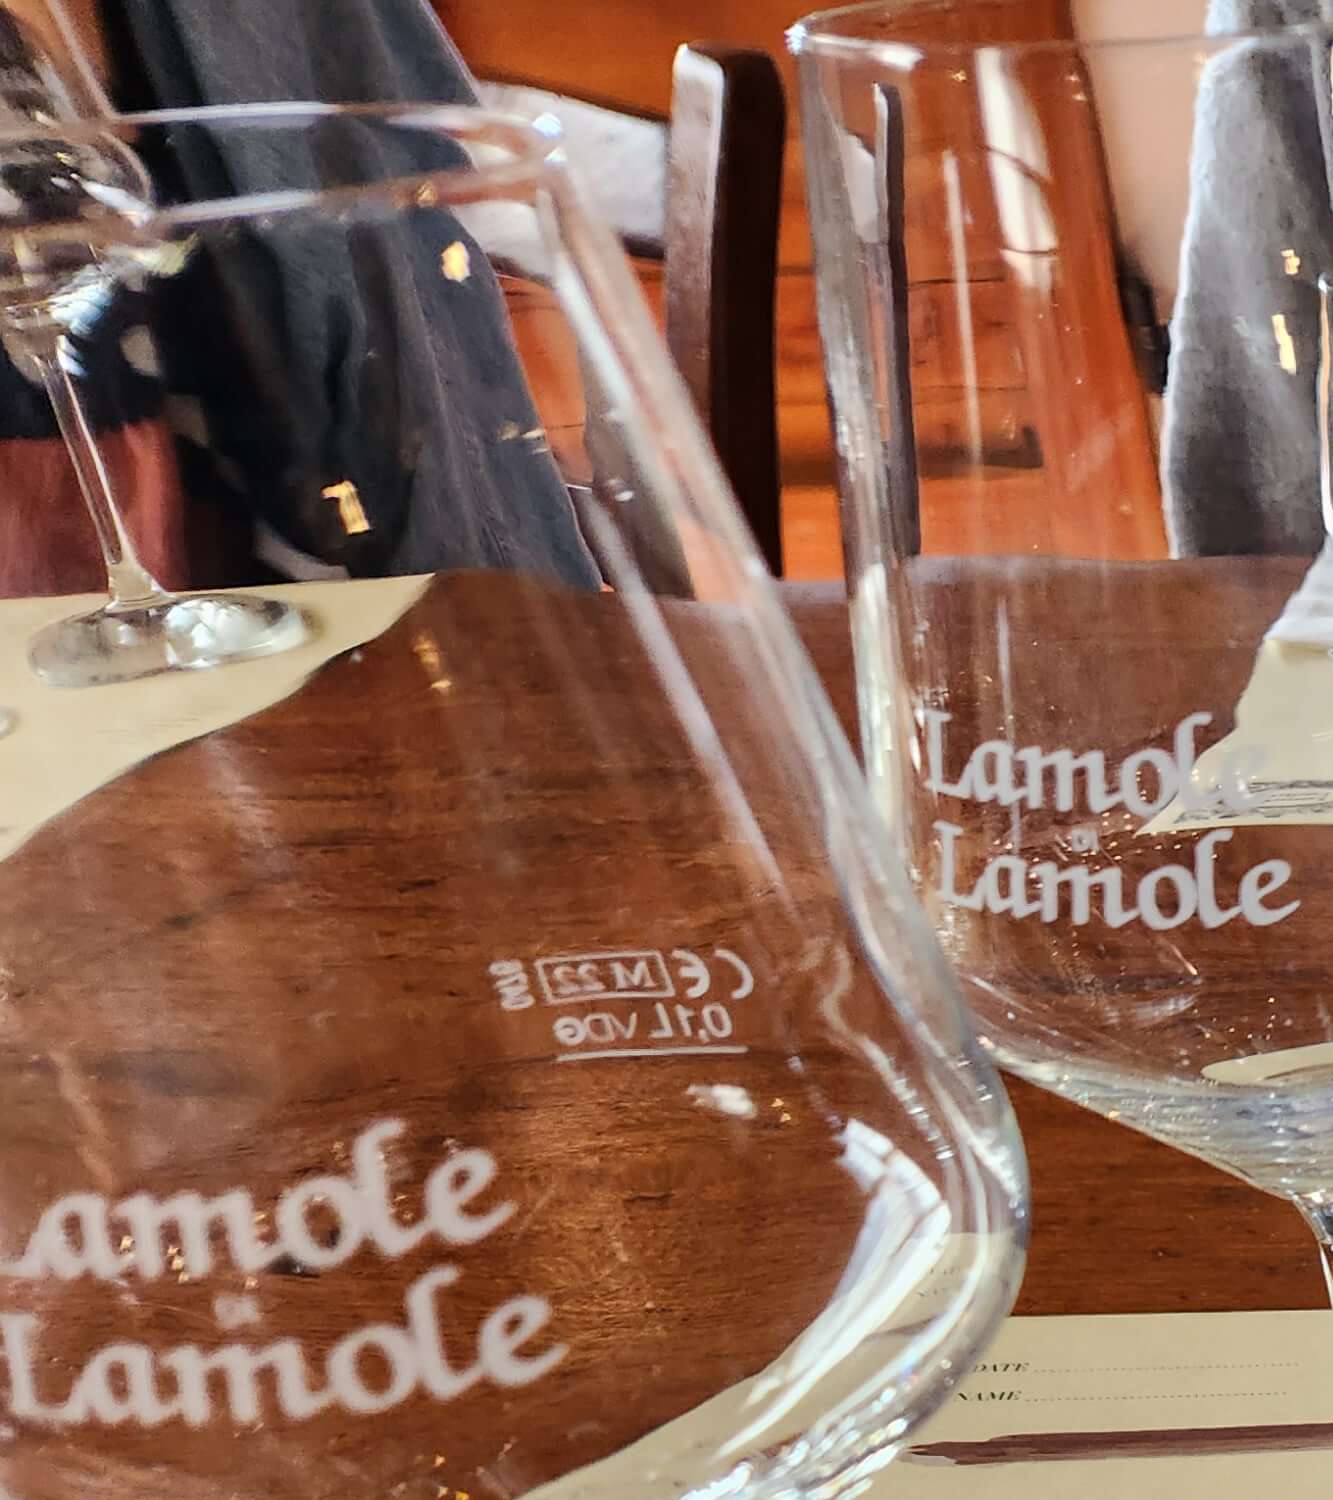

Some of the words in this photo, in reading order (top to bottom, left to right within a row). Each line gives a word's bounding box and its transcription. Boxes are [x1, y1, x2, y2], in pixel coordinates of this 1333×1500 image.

[922, 709, 1272, 819] Lamole
[932, 820, 1302, 931] Lamole
[0, 1265, 570, 1424] Lamole
